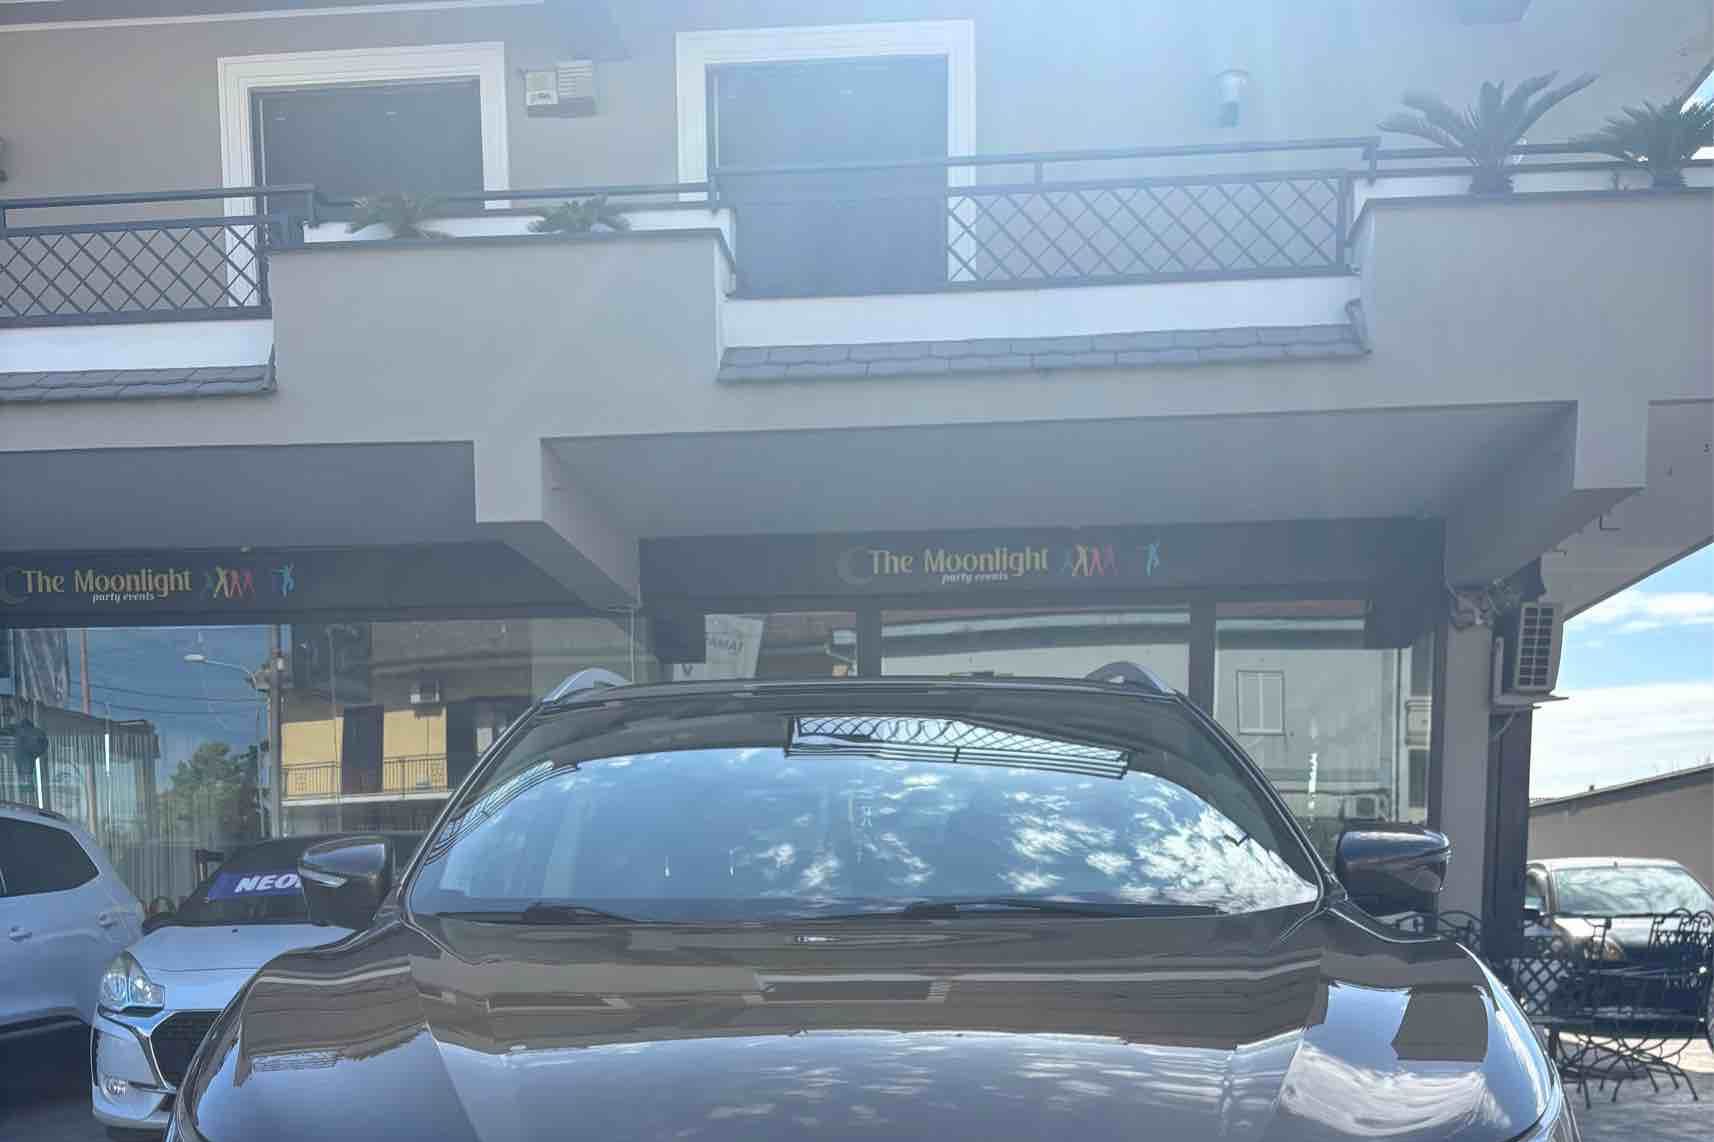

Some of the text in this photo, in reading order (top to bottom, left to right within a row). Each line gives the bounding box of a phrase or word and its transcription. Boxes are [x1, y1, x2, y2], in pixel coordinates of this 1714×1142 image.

[869, 546, 1049, 577] The Moonlight
[21, 568, 193, 598] The Moonlight
[941, 573, 973, 585] party
[92, 590, 156, 605] party events
[234, 872, 304, 893] NEO
